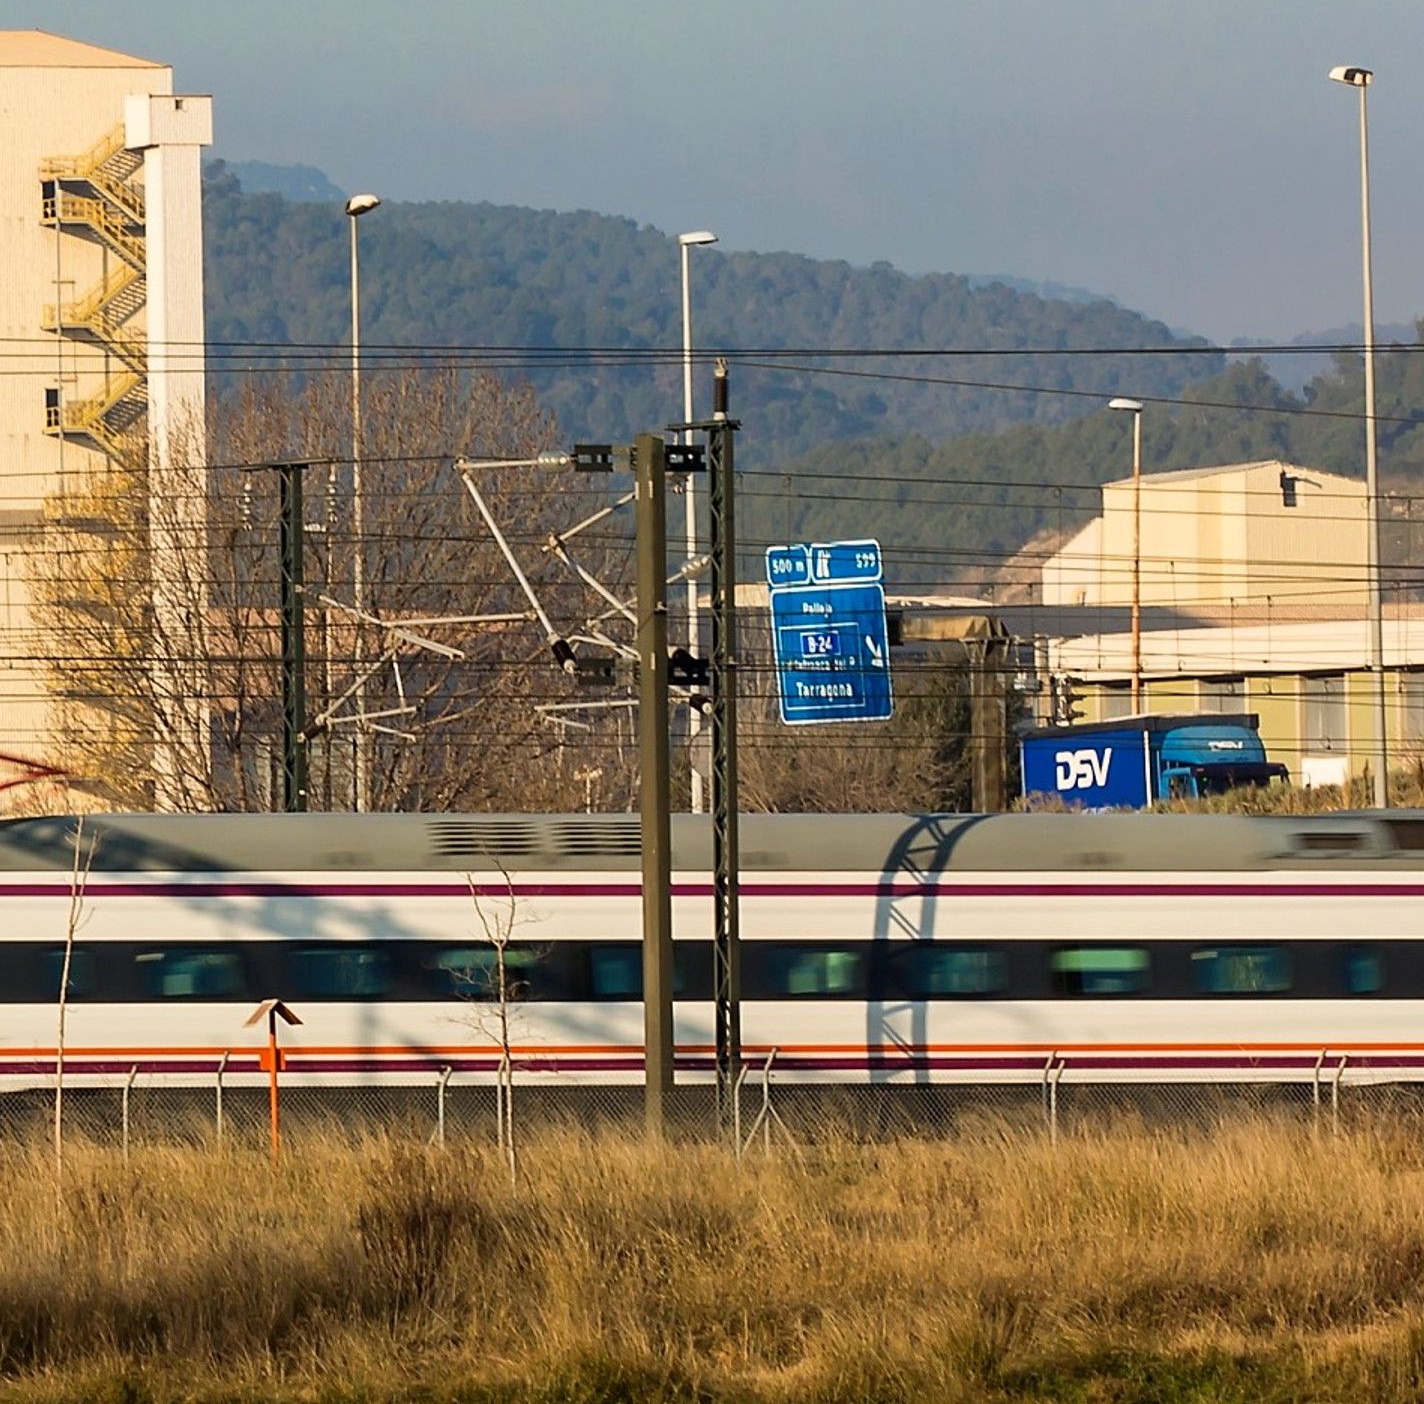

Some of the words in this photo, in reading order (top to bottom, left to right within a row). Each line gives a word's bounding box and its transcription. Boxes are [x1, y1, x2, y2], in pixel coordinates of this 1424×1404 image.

[807, 636, 833, 653] B-24
[796, 682, 853, 703] Tarragona
[1055, 748, 1112, 791] DSV
